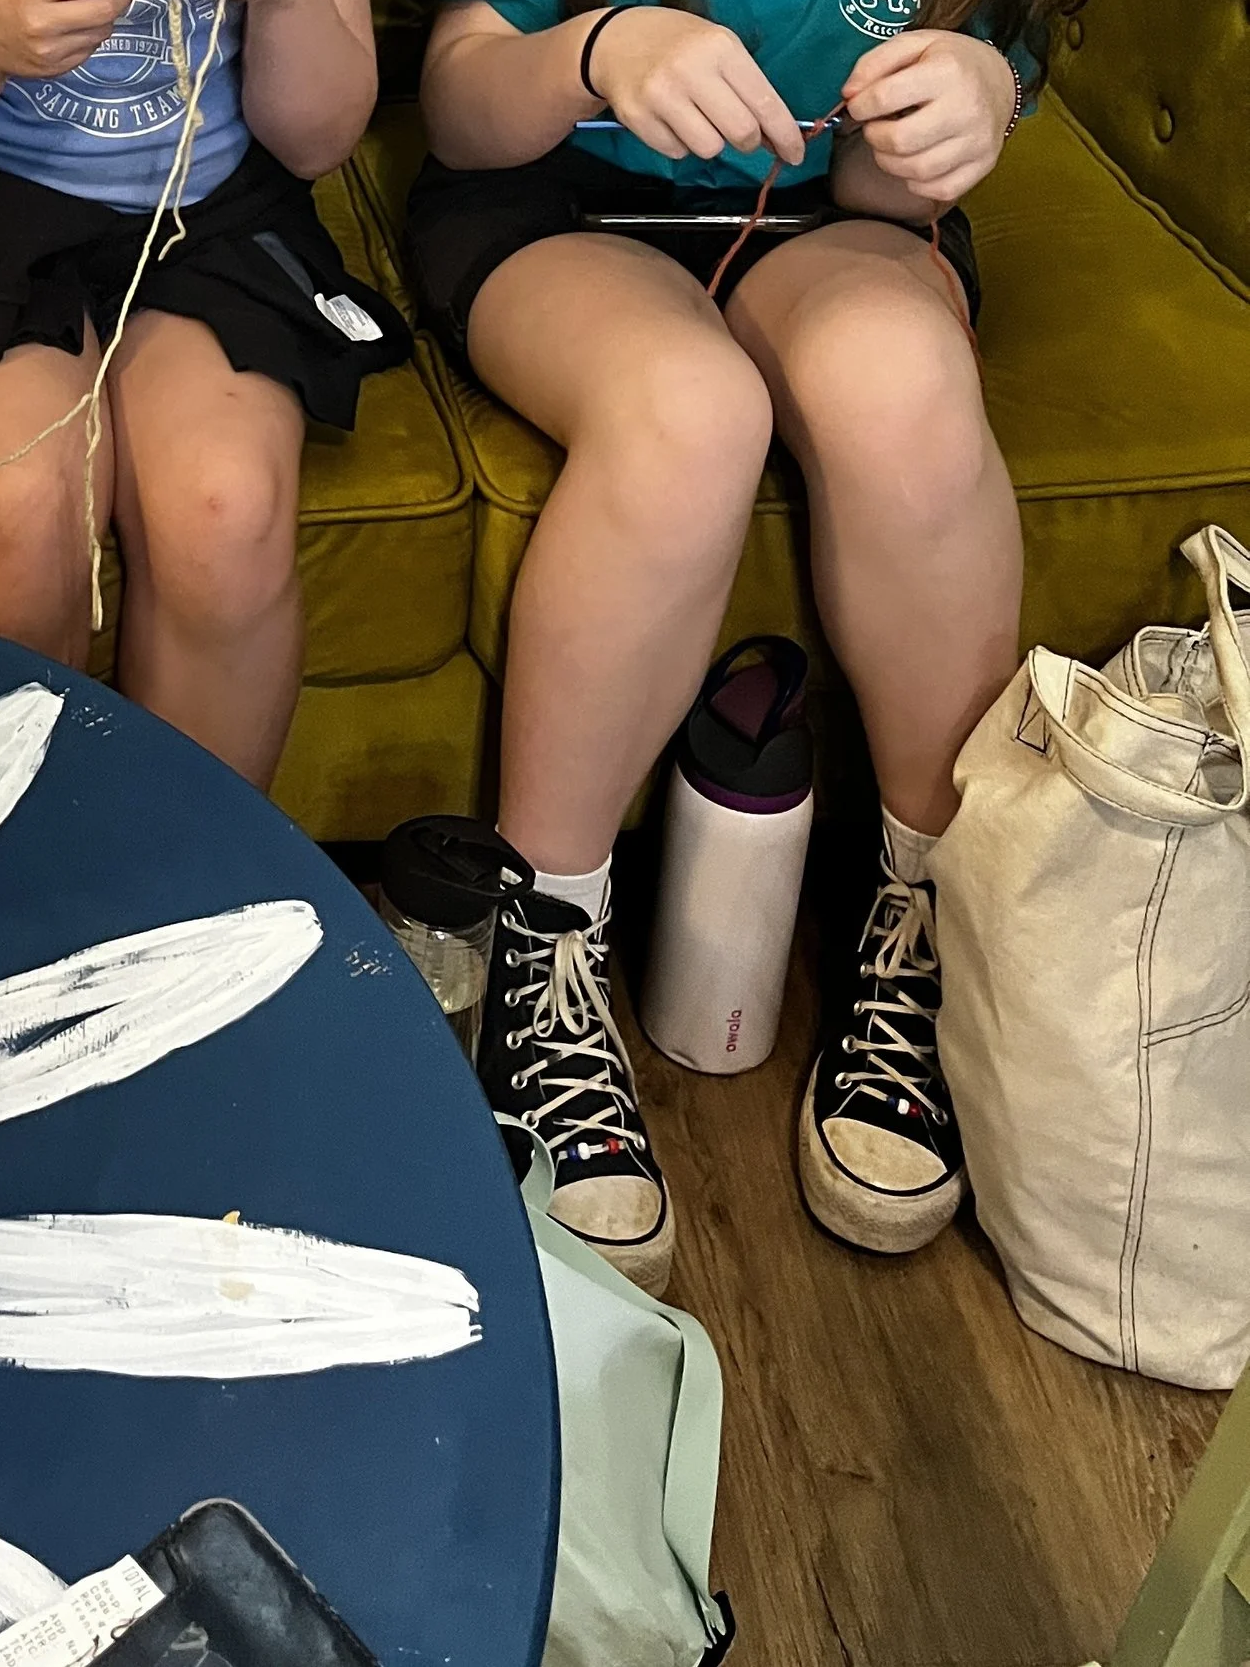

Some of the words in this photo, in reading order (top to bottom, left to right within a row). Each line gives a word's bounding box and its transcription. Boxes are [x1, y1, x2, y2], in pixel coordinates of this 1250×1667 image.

[863, 19, 905, 35] Rescu
[135, 39, 159, 54] 1973
[35, 84, 119, 128] SAILING
[130, 86, 184, 126] TEAM
[726, 1008, 742, 1053] owala
[121, 1565, 152, 1603] TOTAL
